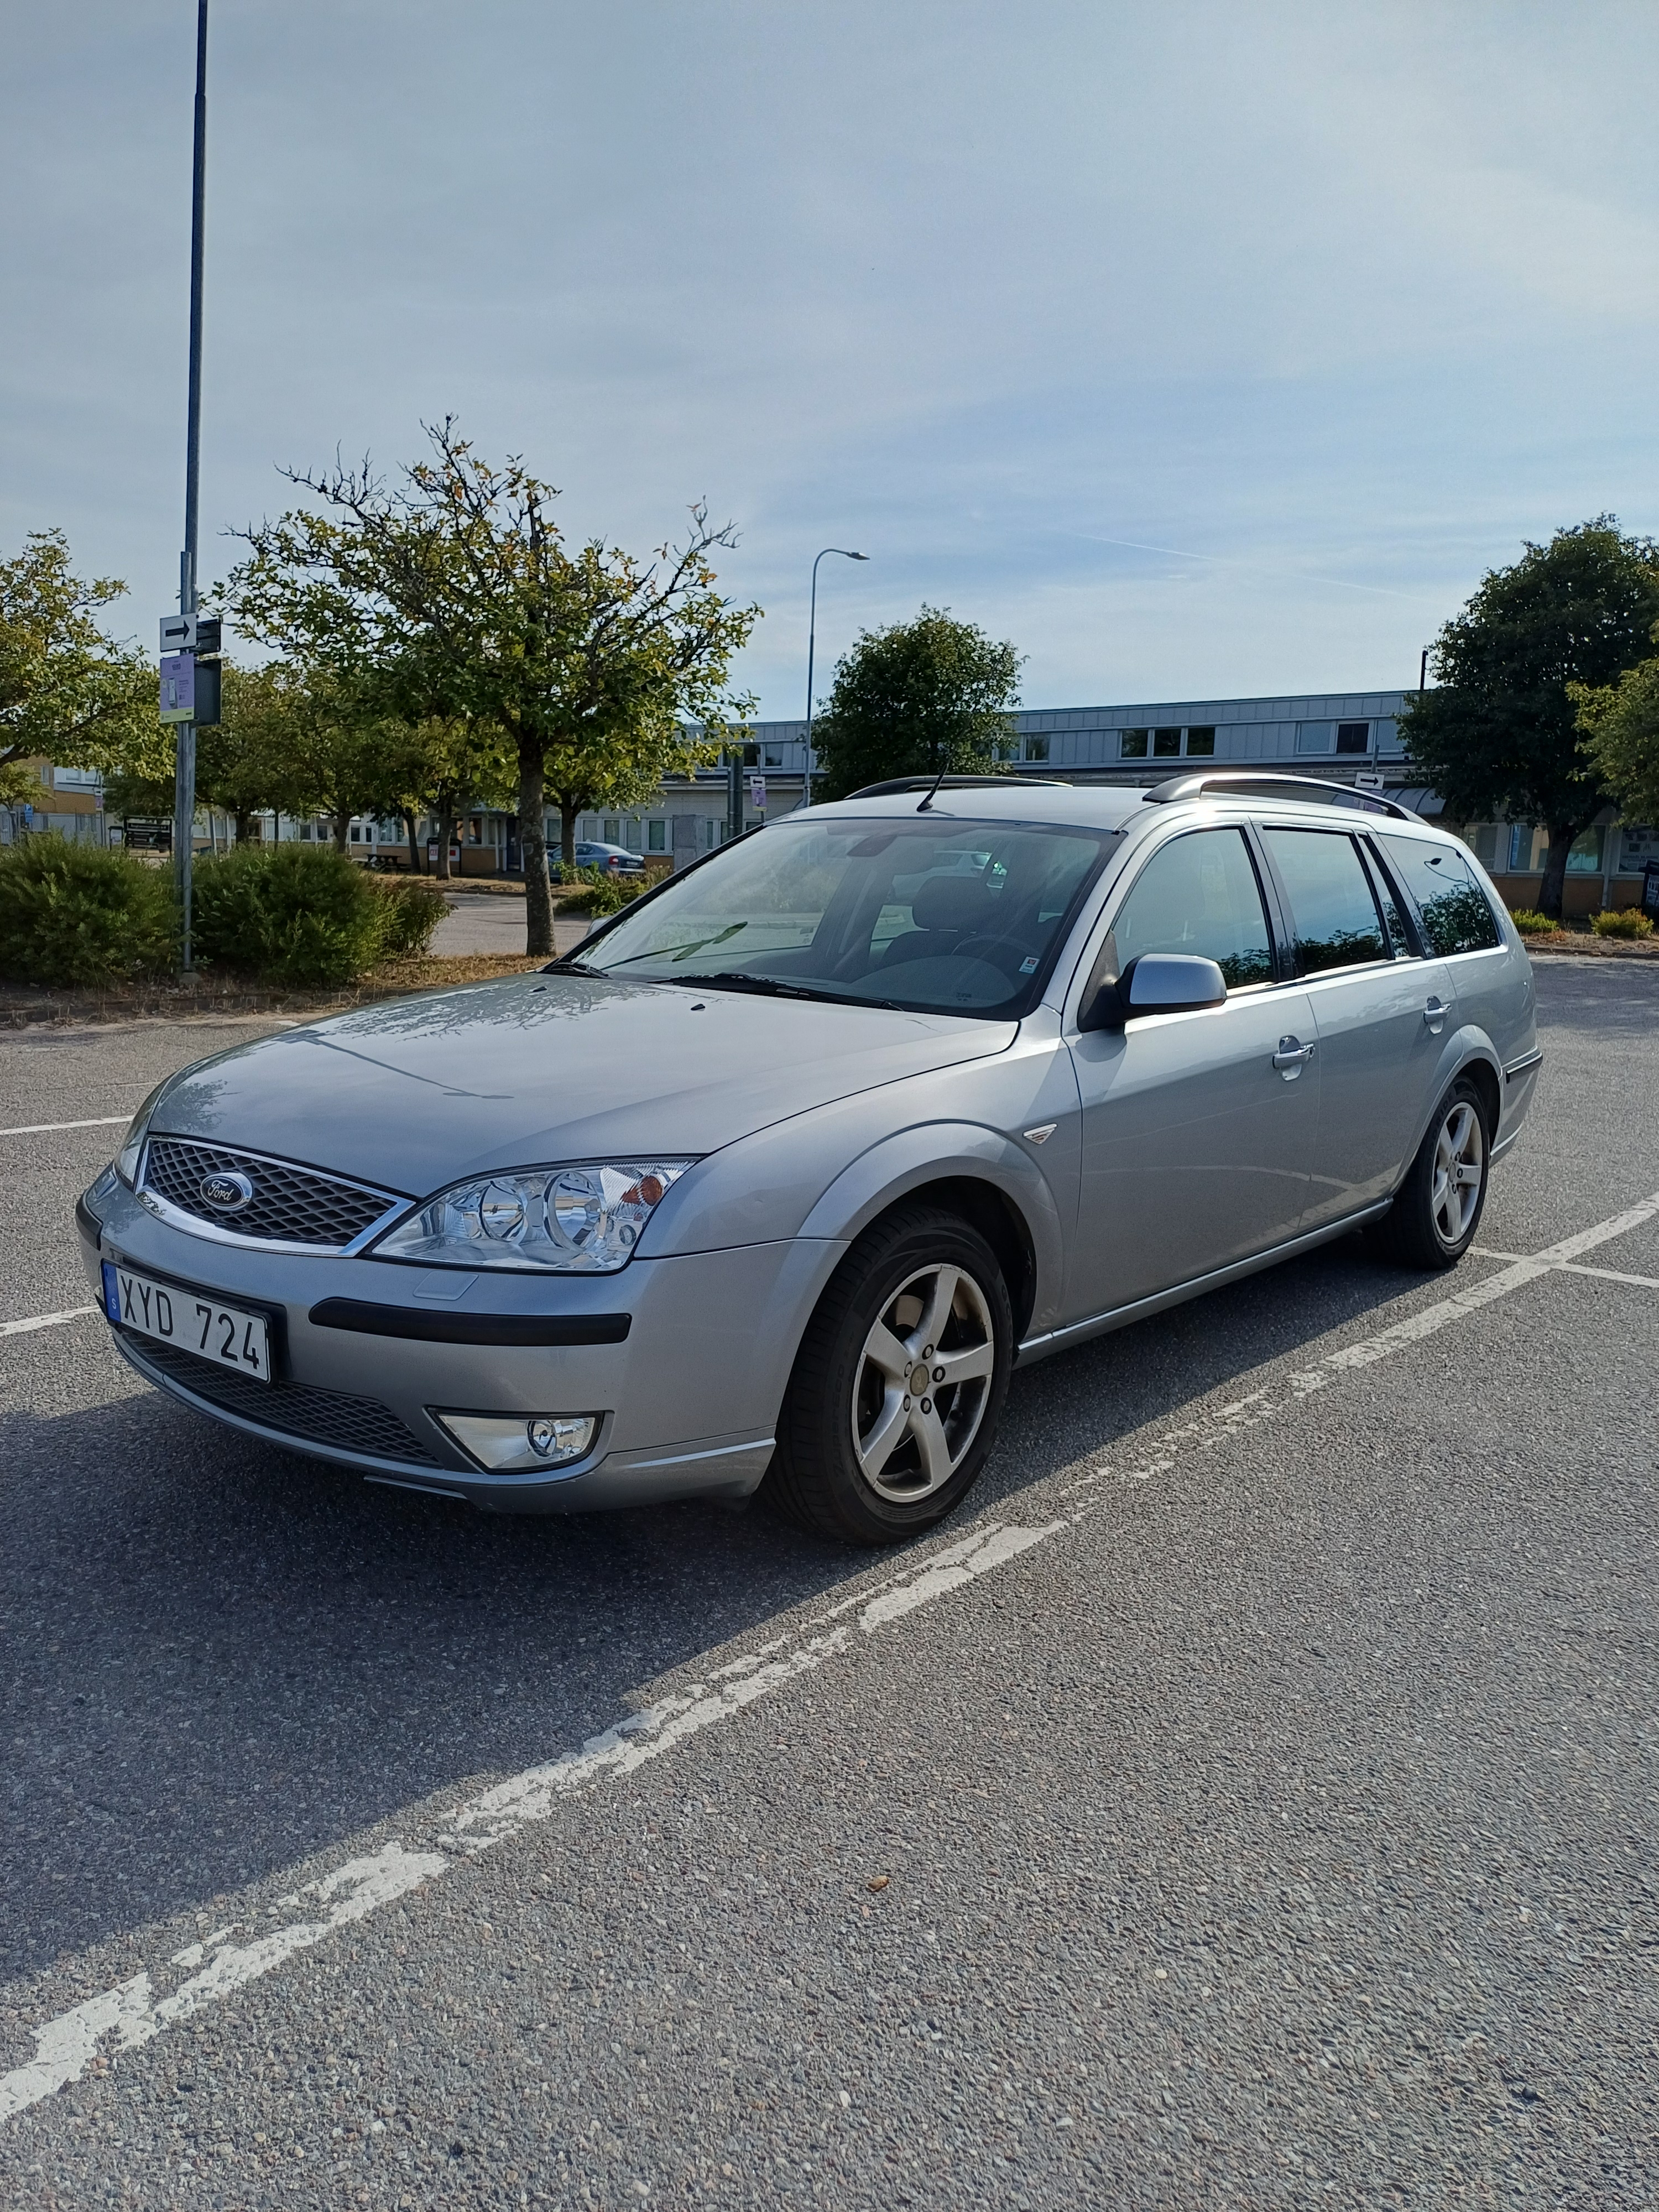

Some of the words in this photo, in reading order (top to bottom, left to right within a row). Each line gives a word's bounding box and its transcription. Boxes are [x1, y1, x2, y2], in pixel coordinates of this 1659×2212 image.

[207, 1180, 234, 1201] Ford
[112, 1298, 117, 1310] S
[120, 1275, 173, 1336] XYD
[196, 1303, 259, 1370] 724
